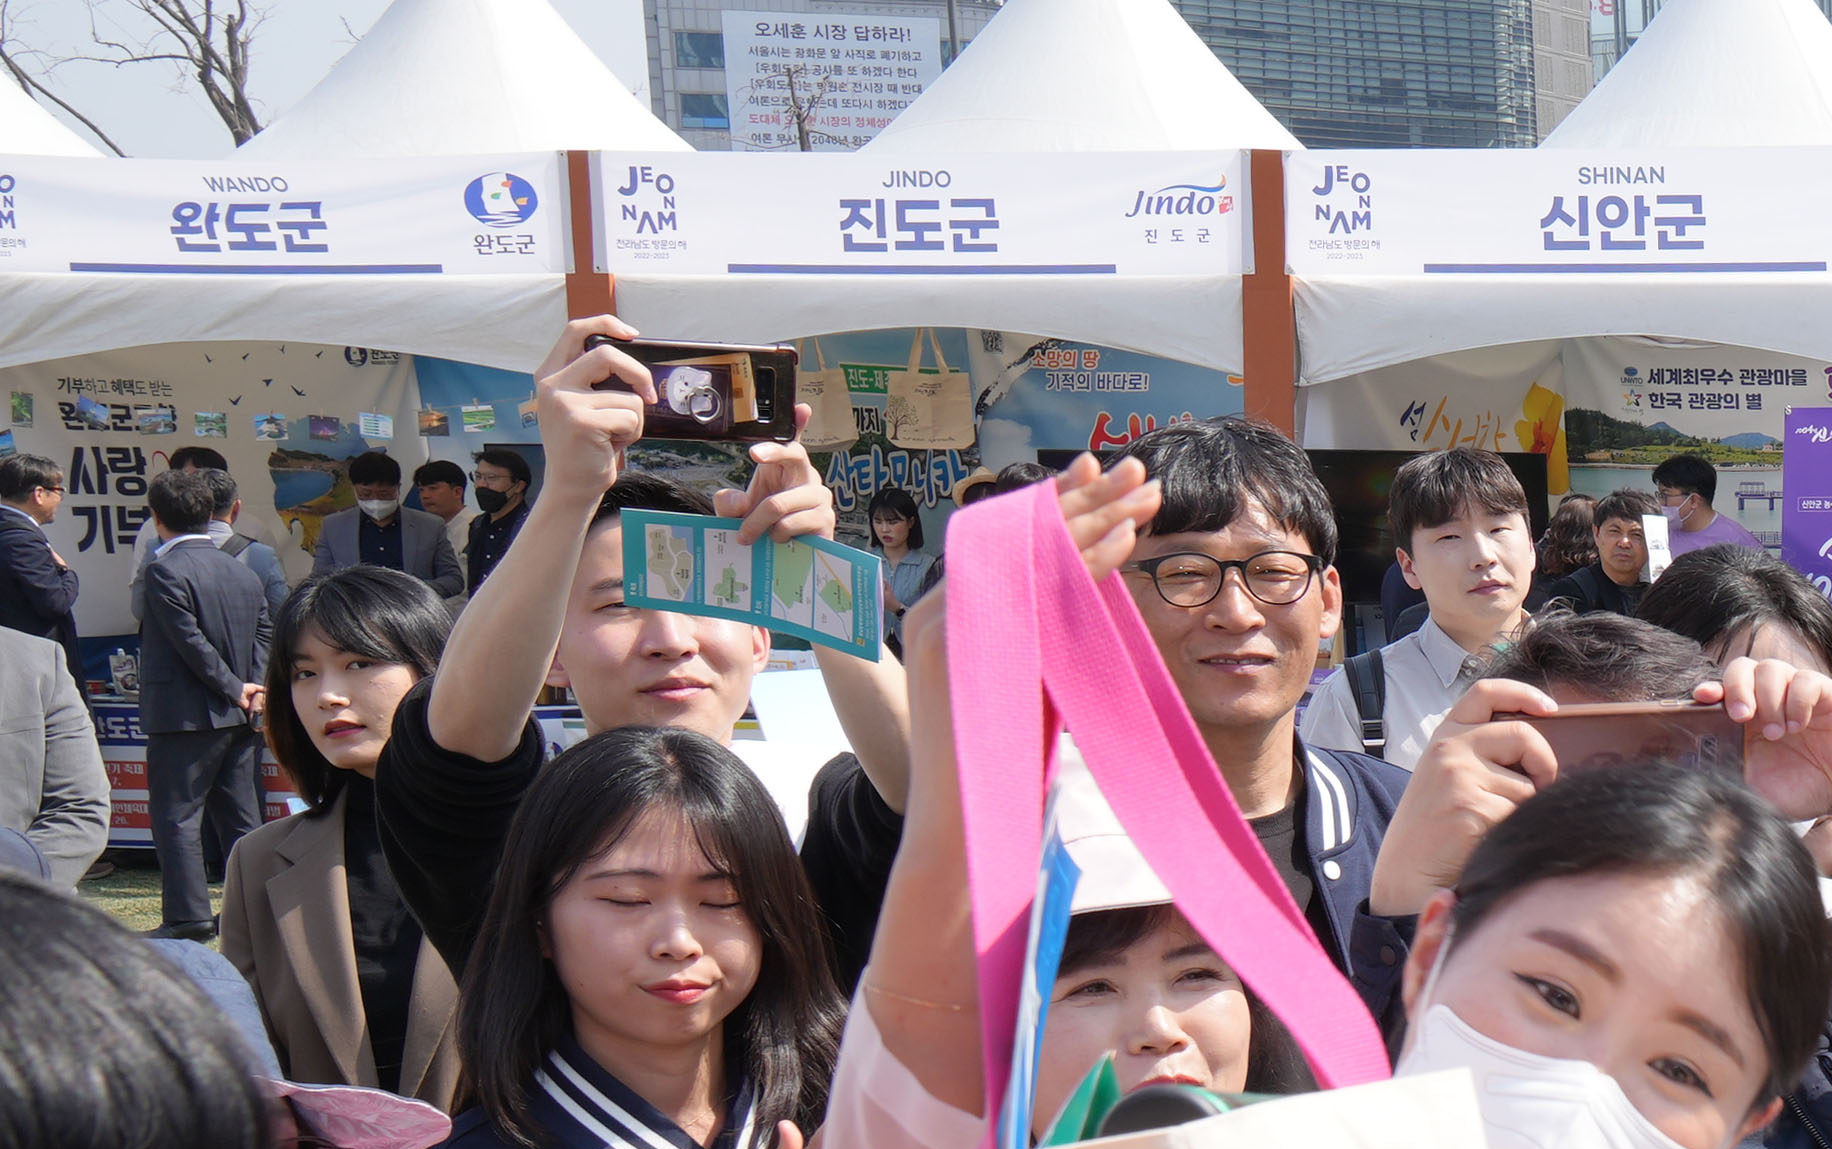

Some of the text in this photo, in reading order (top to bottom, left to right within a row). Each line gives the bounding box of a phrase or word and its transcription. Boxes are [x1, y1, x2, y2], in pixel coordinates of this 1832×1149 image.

[755, 22, 912, 43] 오세훈 시장 답하라!
[748, 46, 792, 60] 서울시는
[897, 67, 918, 78] 한다
[202, 176, 288, 193] WANDO
[882, 170, 951, 188] JINDO
[1578, 166, 1665, 185] SHINAN
[1125, 190, 1215, 218] Jindo
[170, 201, 329, 253] 완도군
[839, 198, 999, 252] 진도군
[1540, 194, 1706, 250] 신안군
[474, 234, 536, 255] 완도군
[1031, 350, 1100, 369] 소망의 땅
[1046, 373, 1149, 391] 기적의 바다로!
[1647, 367, 1808, 387] 세계최우수 관광마을
[57, 377, 173, 397] 기부하고 혜택도 받는
[1648, 392, 1683, 411] 한국
[1688, 392, 1740, 411] 관광의
[1745, 392, 1763, 411] 별
[69, 446, 148, 496] 사랑
[1801, 499, 1822, 510] 신안군
